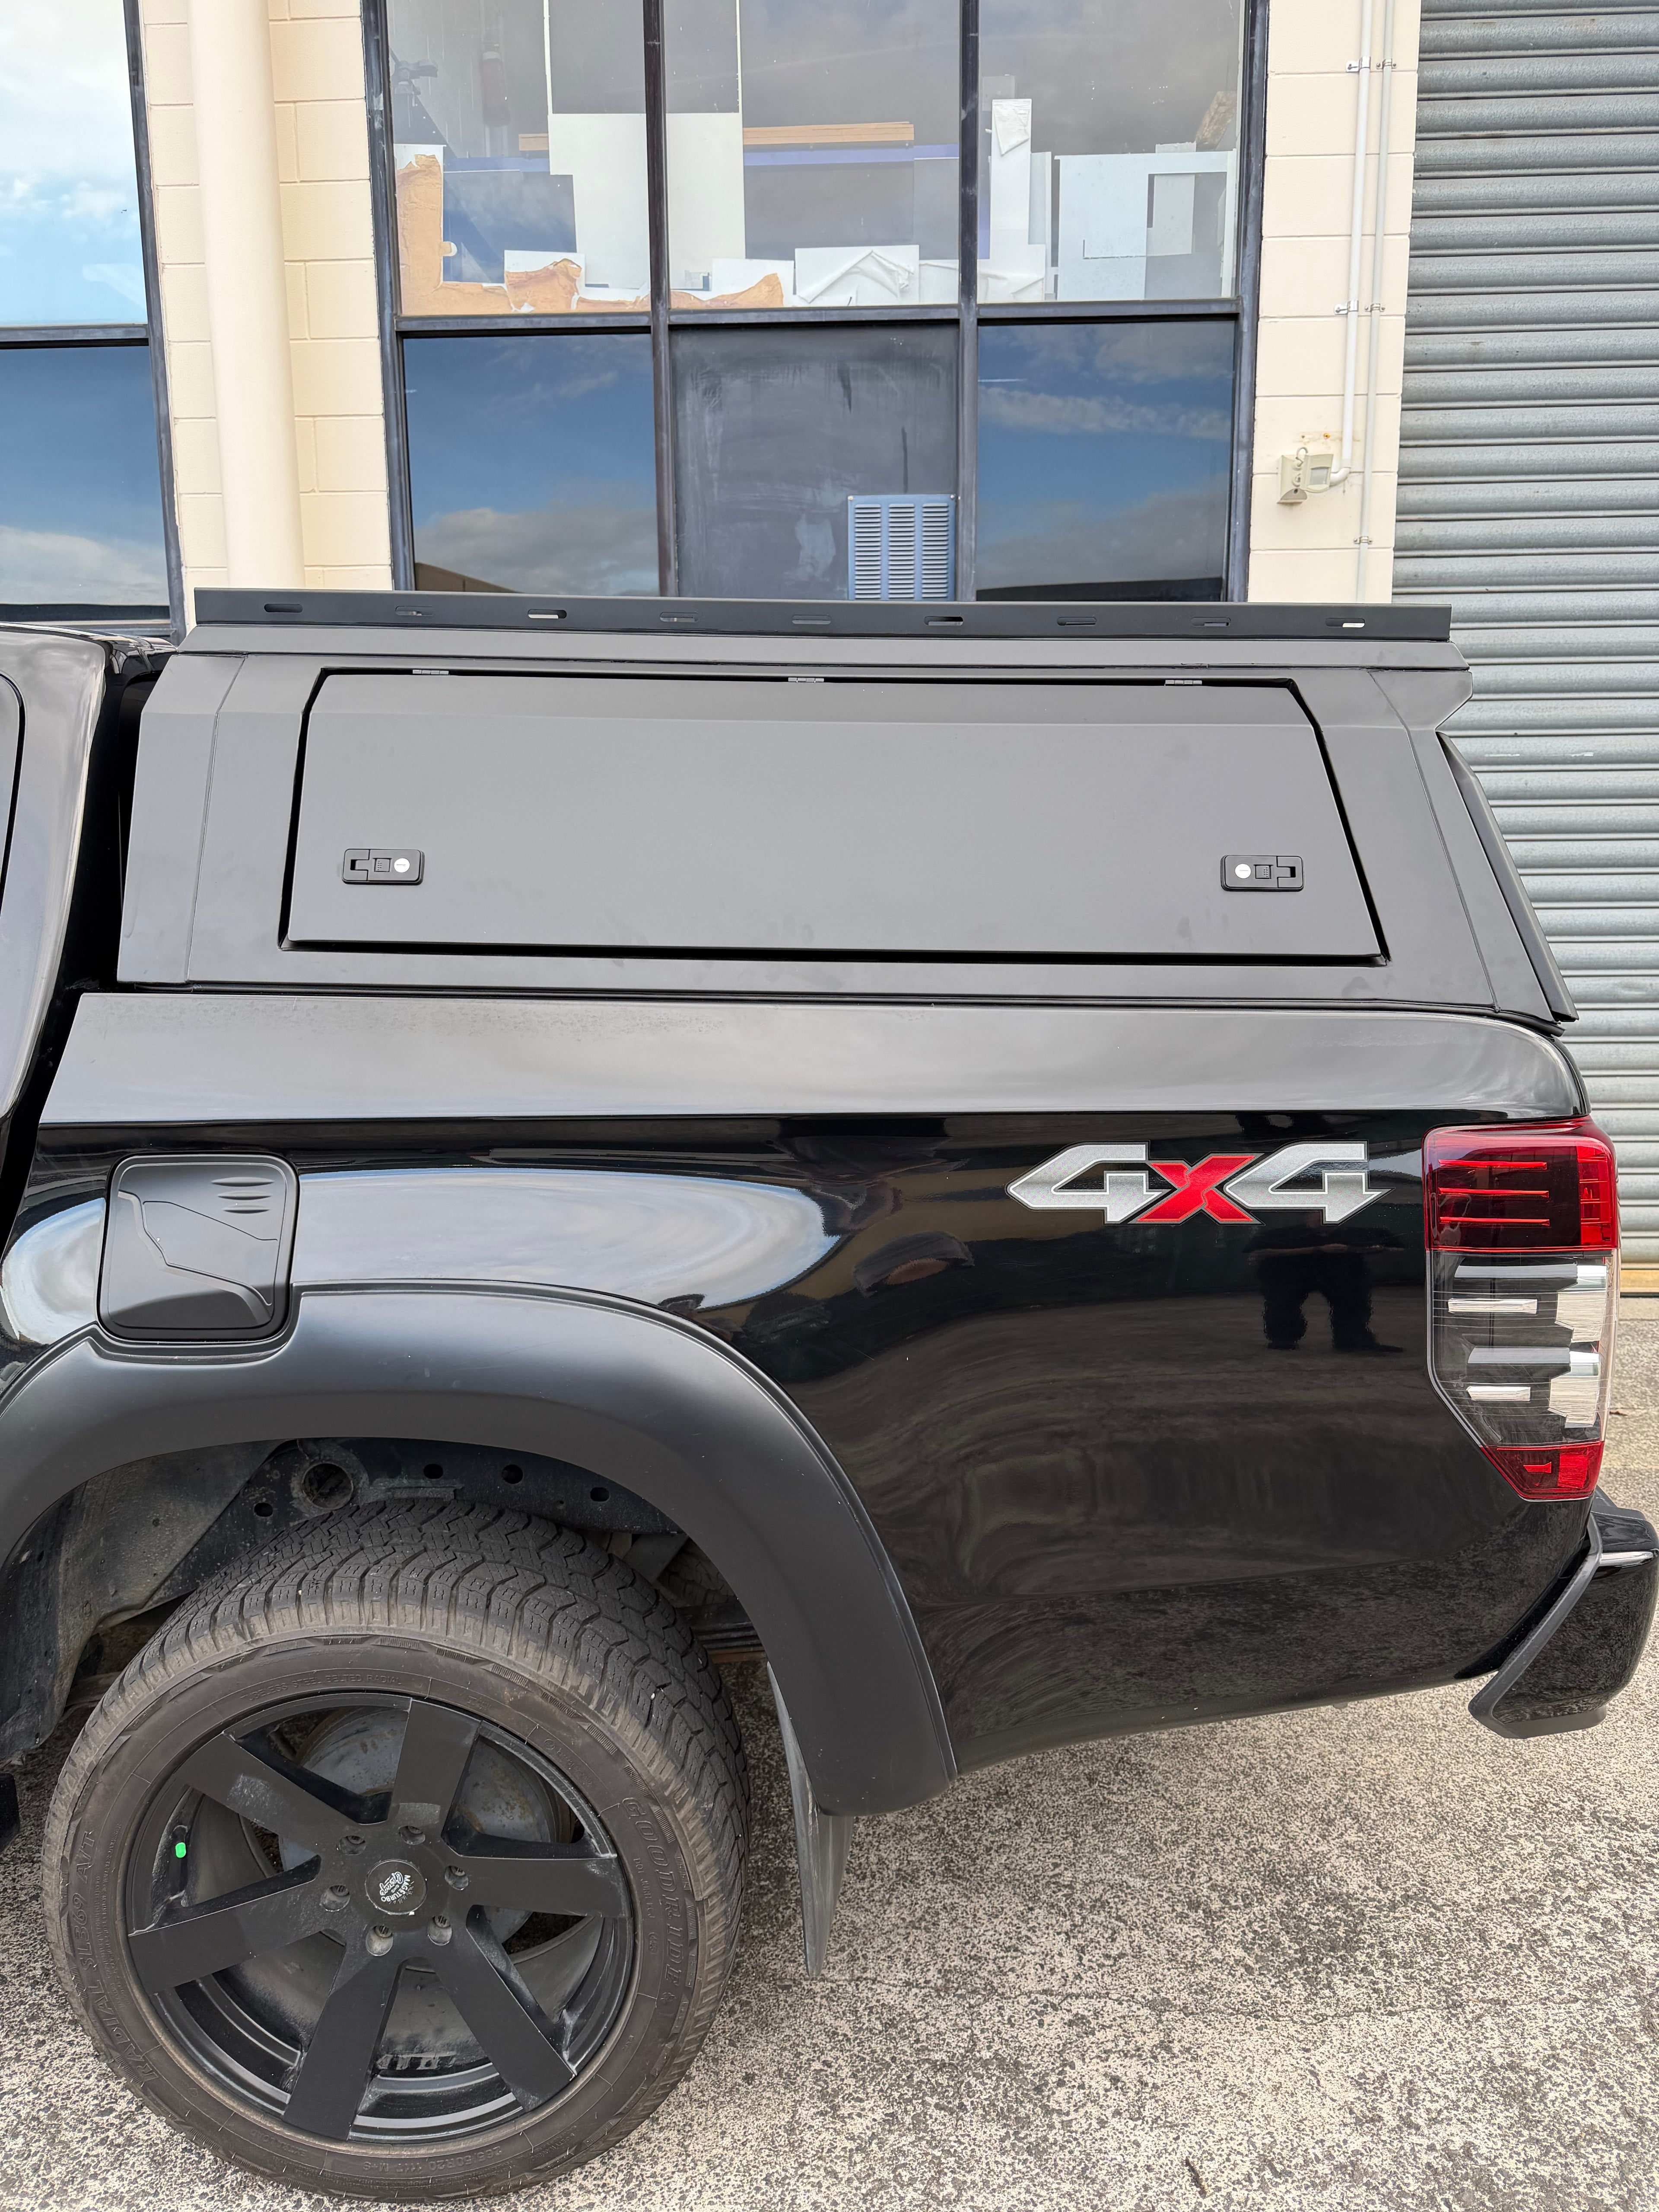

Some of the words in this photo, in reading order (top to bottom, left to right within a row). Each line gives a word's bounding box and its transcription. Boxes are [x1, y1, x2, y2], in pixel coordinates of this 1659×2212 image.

[290, 1675, 322, 1688] STEEL
[324, 1673, 362, 1683] BELTED
[365, 1674, 403, 1685] RADIAL
[73, 1830, 99, 1884] A/T
[621, 1796, 684, 1986] GOODRIDE
[72, 1891, 99, 1974] SL369
[85, 1979, 158, 2085] RADIAL
[426, 2144, 504, 2172] 265/50R20
